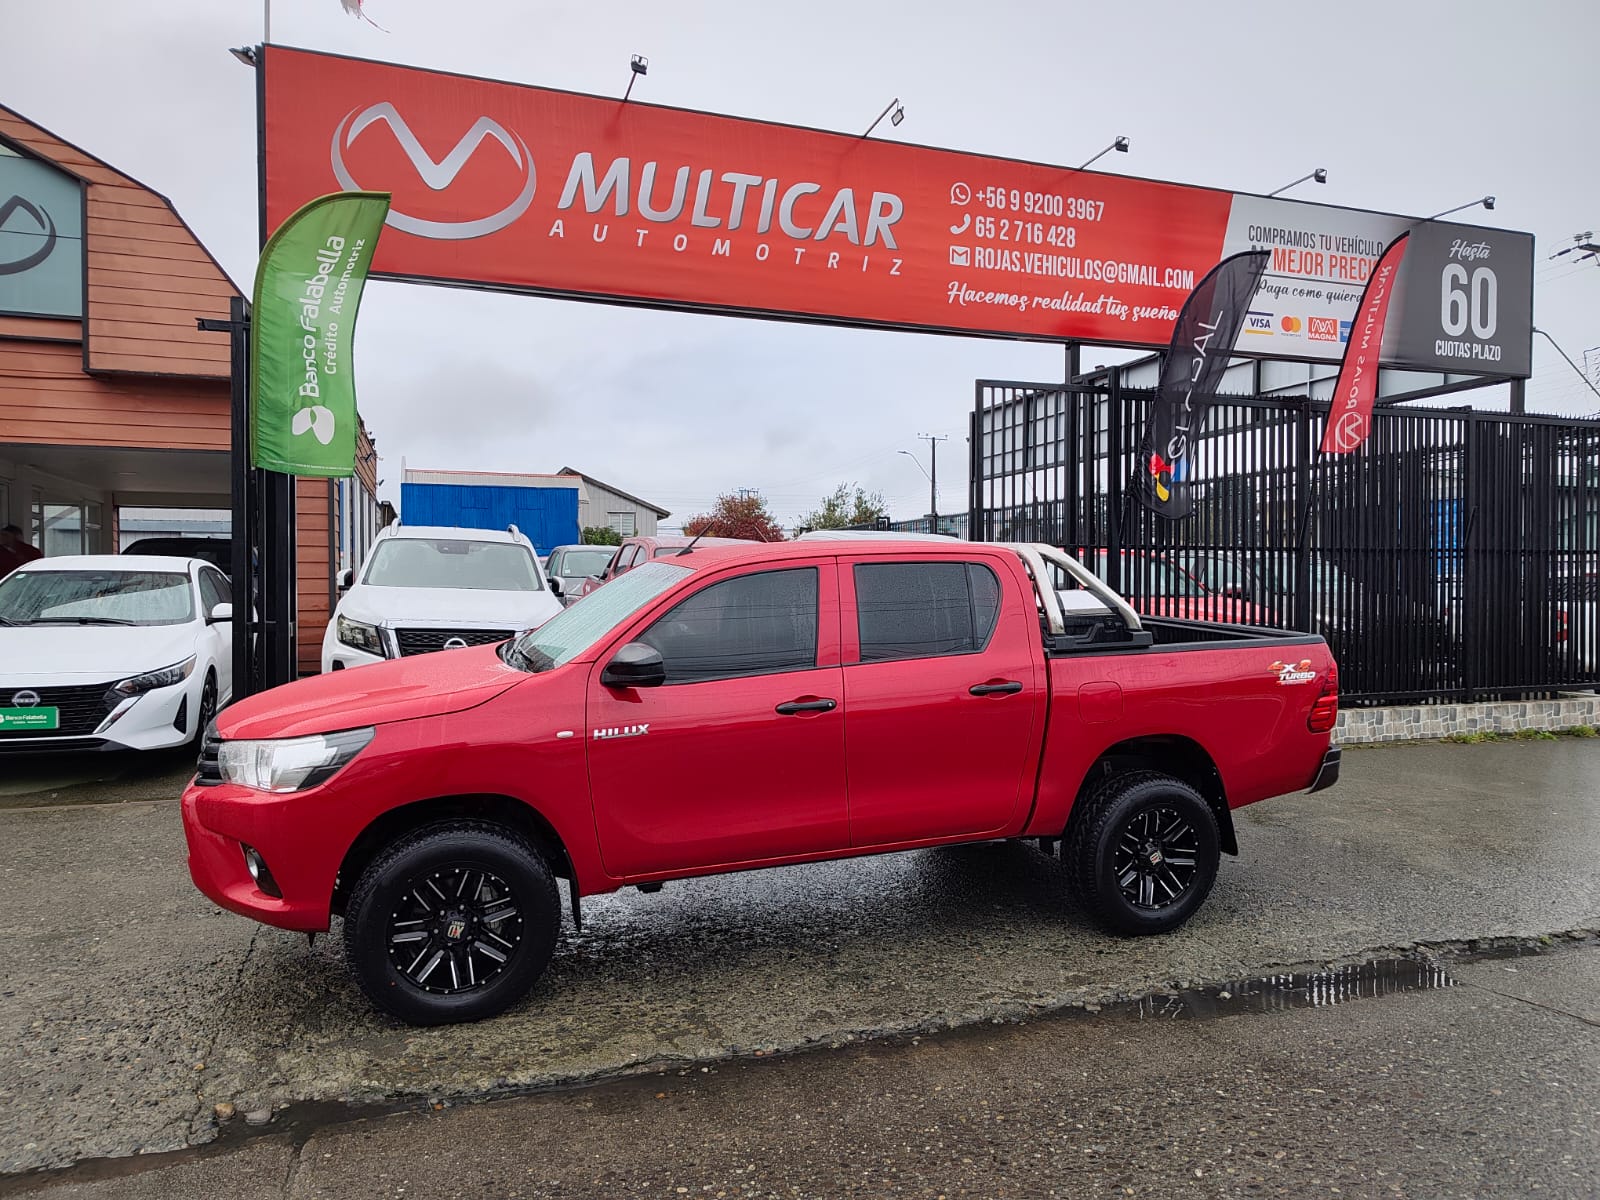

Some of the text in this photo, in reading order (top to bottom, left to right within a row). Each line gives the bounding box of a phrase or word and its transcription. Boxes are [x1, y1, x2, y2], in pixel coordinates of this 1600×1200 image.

[556, 152, 903, 249] MULTICAR
[976, 186, 1104, 222] +56 9 9200 3967
[548, 219, 903, 276] AUTOMOTRIZ
[975, 216, 1076, 248] 65 2 716 428
[1248, 225, 1383, 257] COMPRAMOS TU VEHÍCULO
[1273, 247, 1324, 276] MEJOR
[1449, 238, 1491, 261] Hasta
[974, 246, 1195, 290] ROJAS.VEHICULOS@GMAIL.COM
[324, 238, 366, 375] Crédito Automotriz
[947, 281, 1180, 322] Hacemos realidad tus sueño
[1255, 279, 1361, 304] Paga como quiera
[1441, 263, 1498, 340] 60
[299, 235, 345, 398] Banco Falabella
[1250, 317, 1271, 329] VISA
[1308, 332, 1337, 341] MAGNA
[1435, 339, 1501, 361] CUOTAS PLAZO
[1279, 671, 1316, 681] TURBO
[593, 723, 650, 740] HILUX
